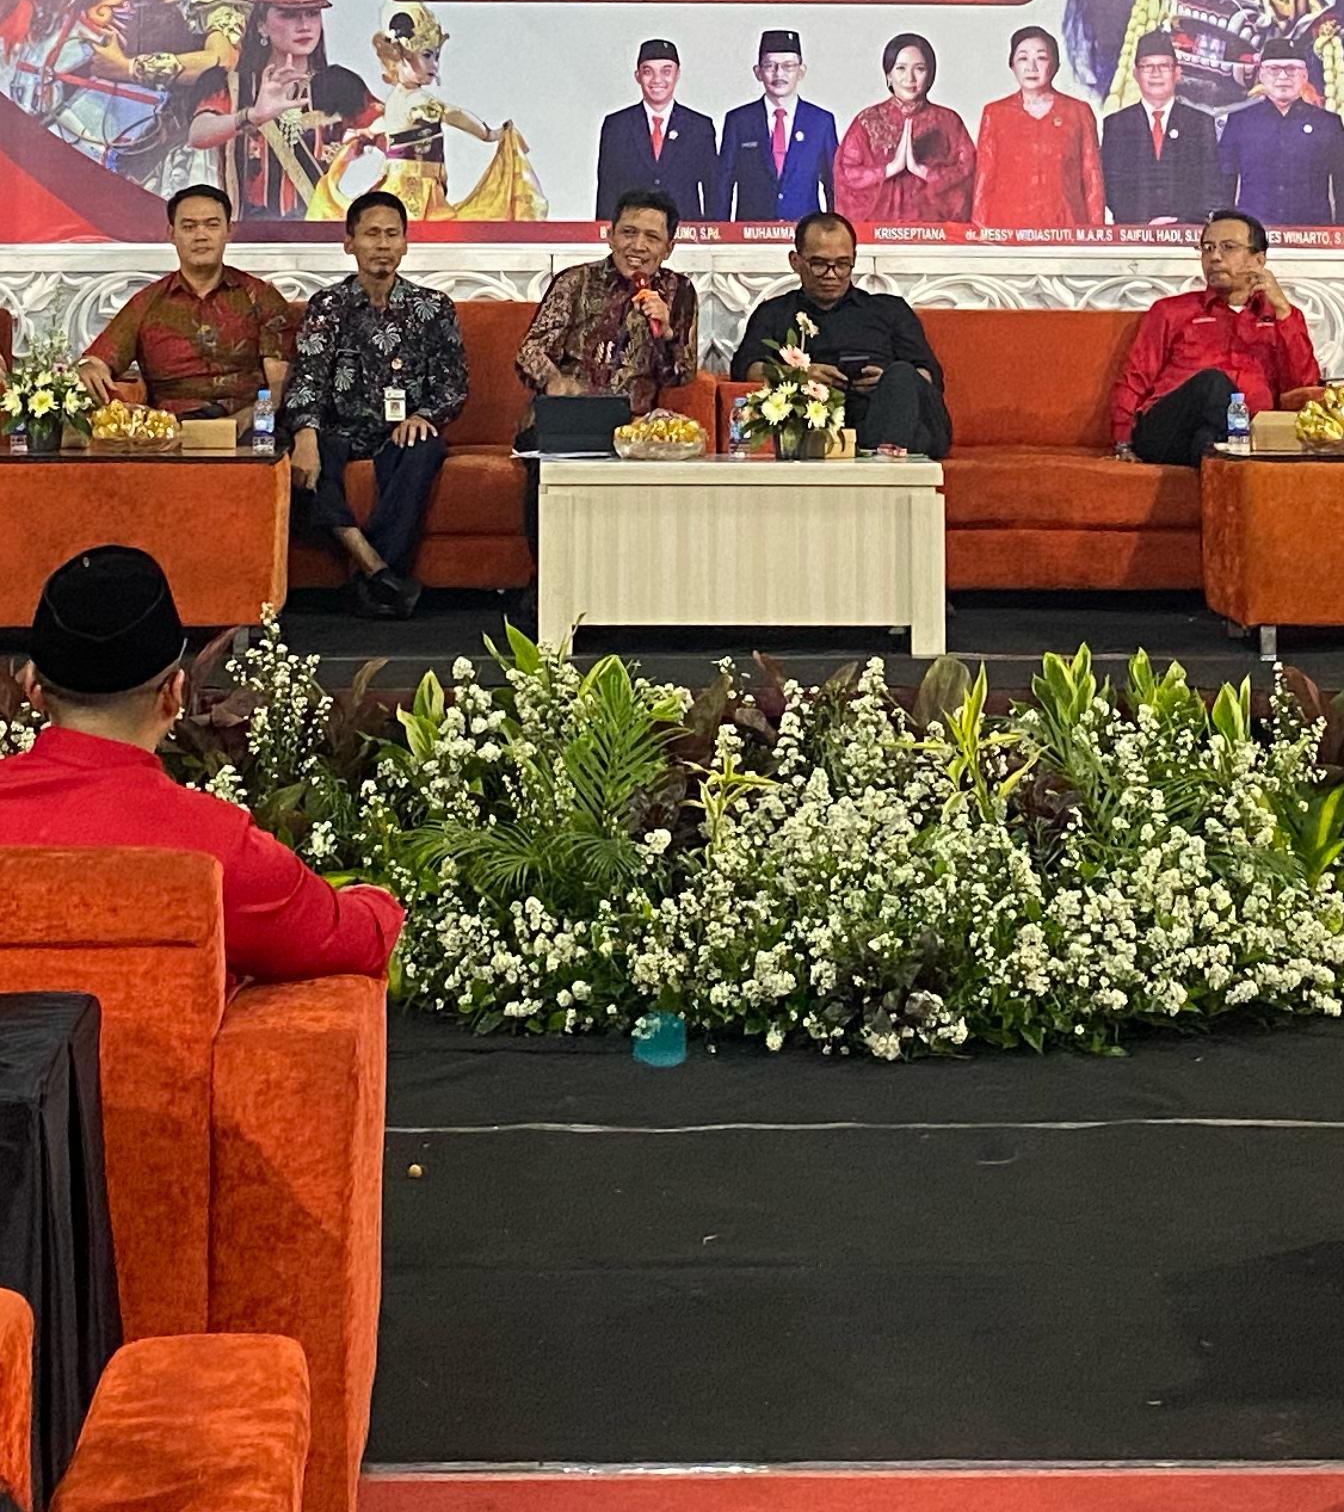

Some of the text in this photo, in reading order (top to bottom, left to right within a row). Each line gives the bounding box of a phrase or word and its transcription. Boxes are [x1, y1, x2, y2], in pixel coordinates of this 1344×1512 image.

[743, 226, 796, 240] MUHAMMA
[874, 227, 946, 241] KRISSEPTIANA
[1120, 228, 1155, 242] SAIFUL
